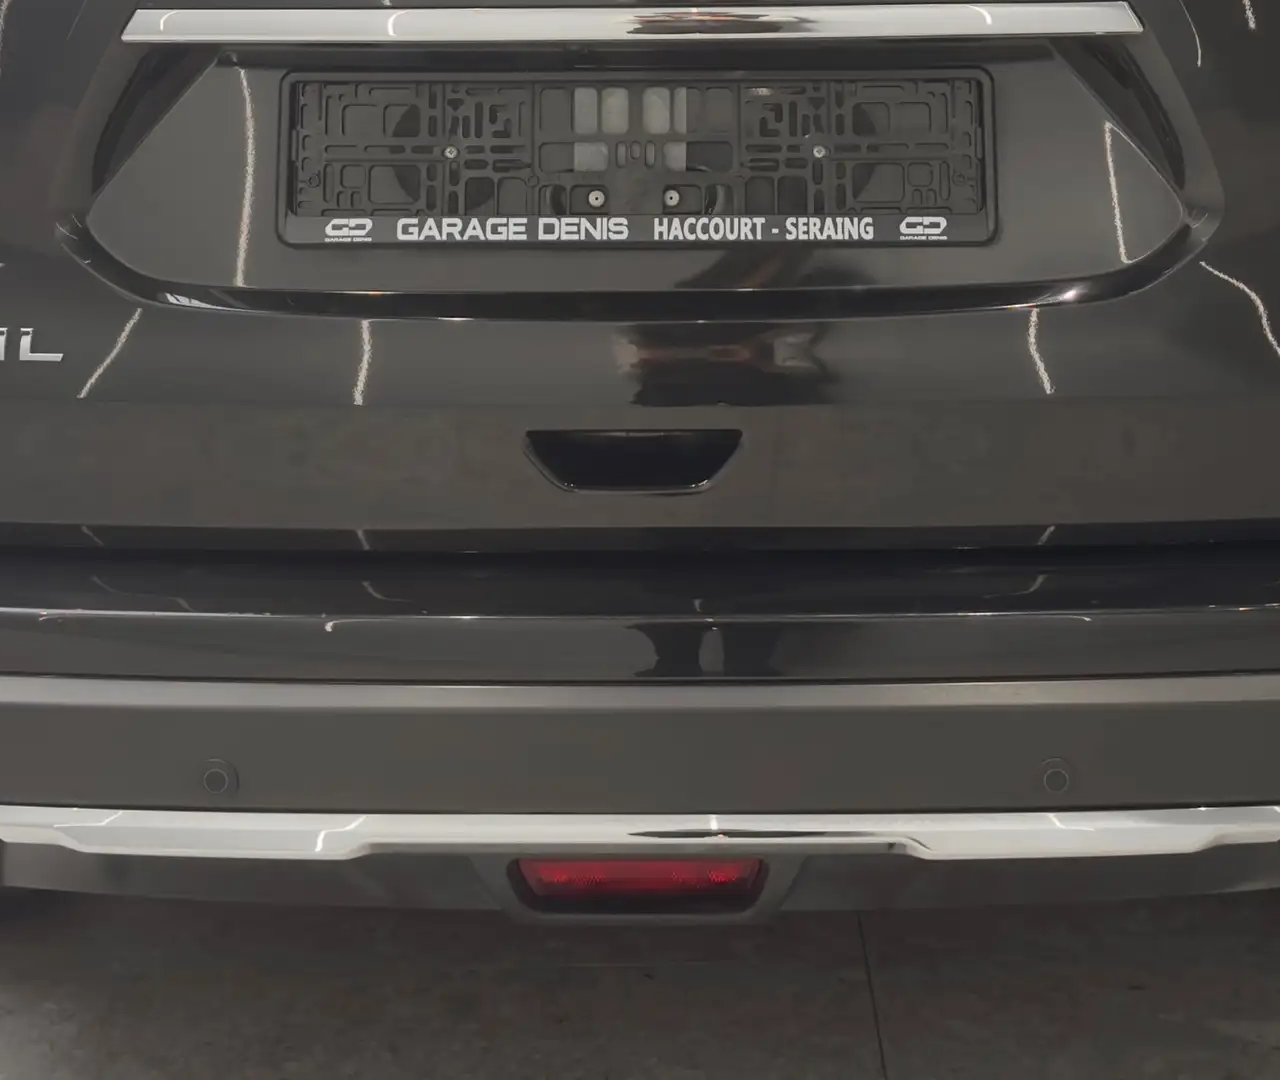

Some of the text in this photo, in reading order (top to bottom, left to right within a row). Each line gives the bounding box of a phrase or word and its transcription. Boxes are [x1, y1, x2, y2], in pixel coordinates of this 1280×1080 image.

[396, 217, 528, 241] GARAGE
[538, 217, 630, 241] DENIS
[653, 216, 766, 241] HACCOURT
[785, 216, 874, 240] SERAING
